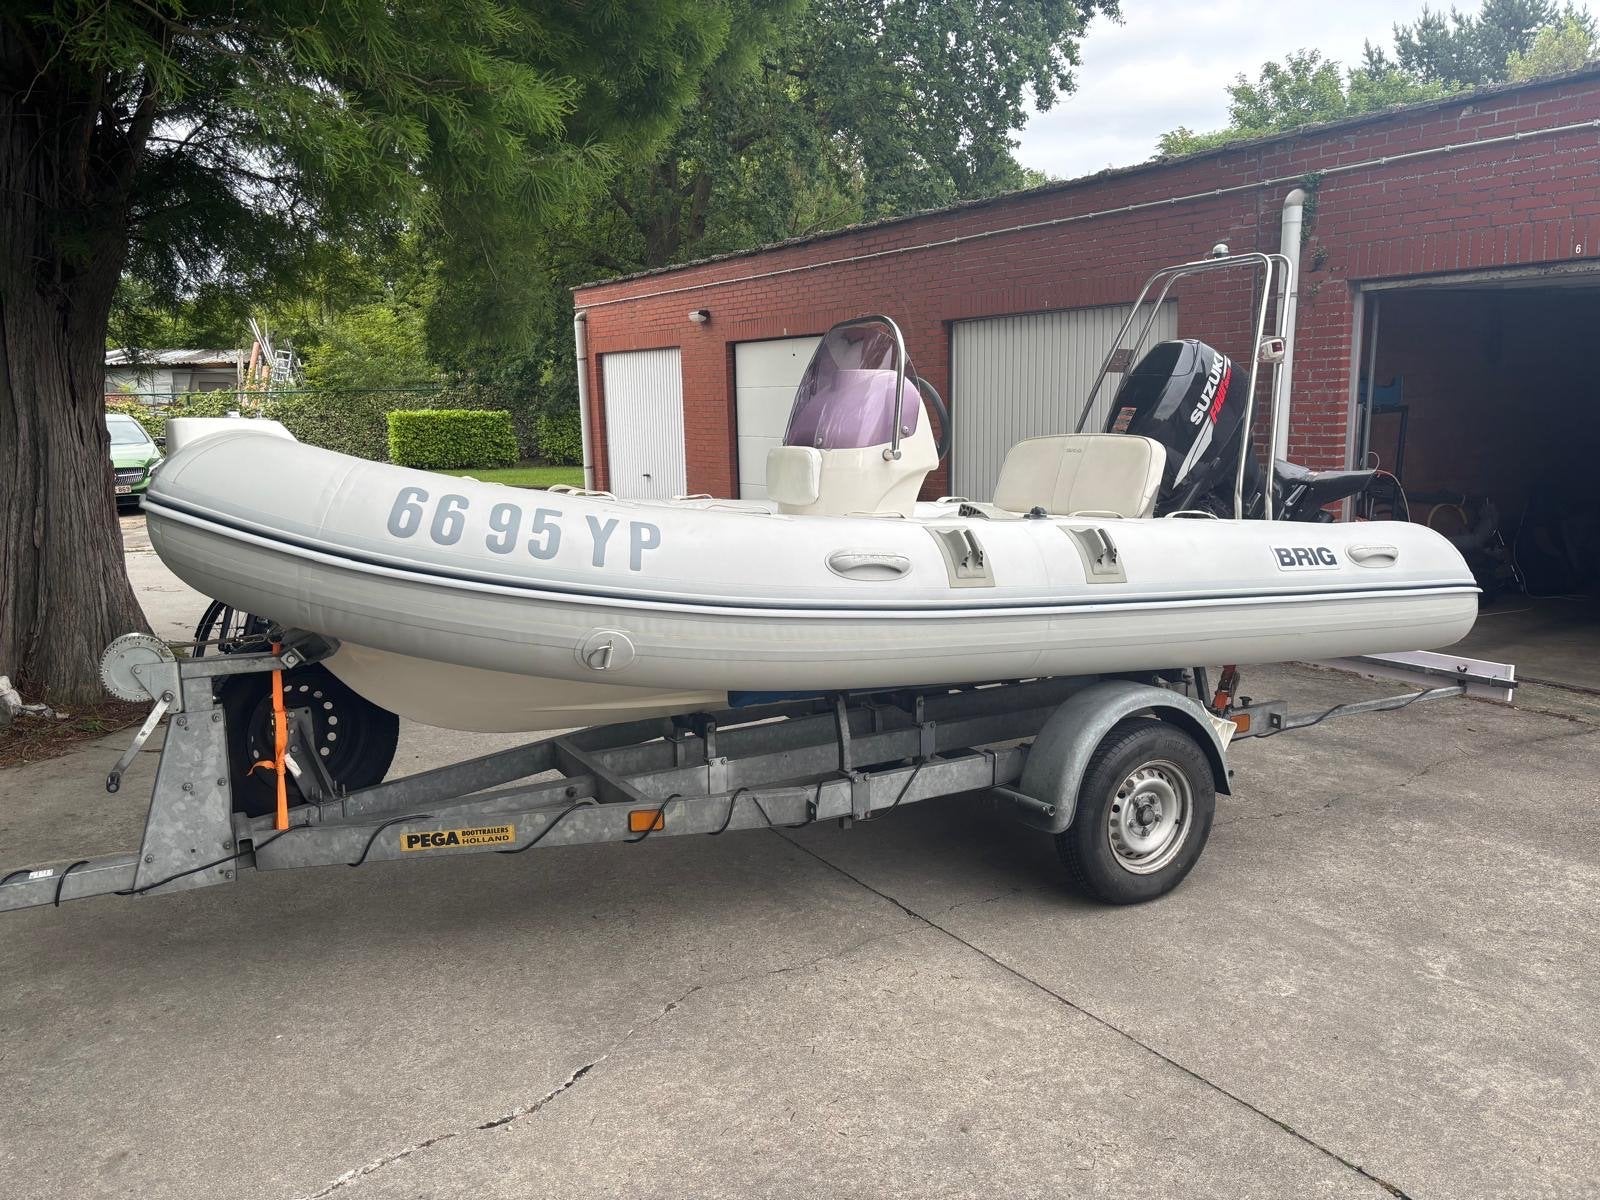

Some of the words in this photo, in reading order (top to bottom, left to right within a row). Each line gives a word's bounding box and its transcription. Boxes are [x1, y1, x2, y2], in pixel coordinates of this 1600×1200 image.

[1575, 244, 1582, 254] 6
[1190, 352, 1224, 425] SUZUKI
[387, 486, 470, 546] 66
[485, 502, 563, 560] 95
[585, 514, 661, 572] YP
[1274, 546, 1338, 567] BRIG
[406, 831, 460, 849] PEGA
[461, 827, 509, 837] BOOTTRAILERS
[462, 835, 509, 845] HOLLAND
